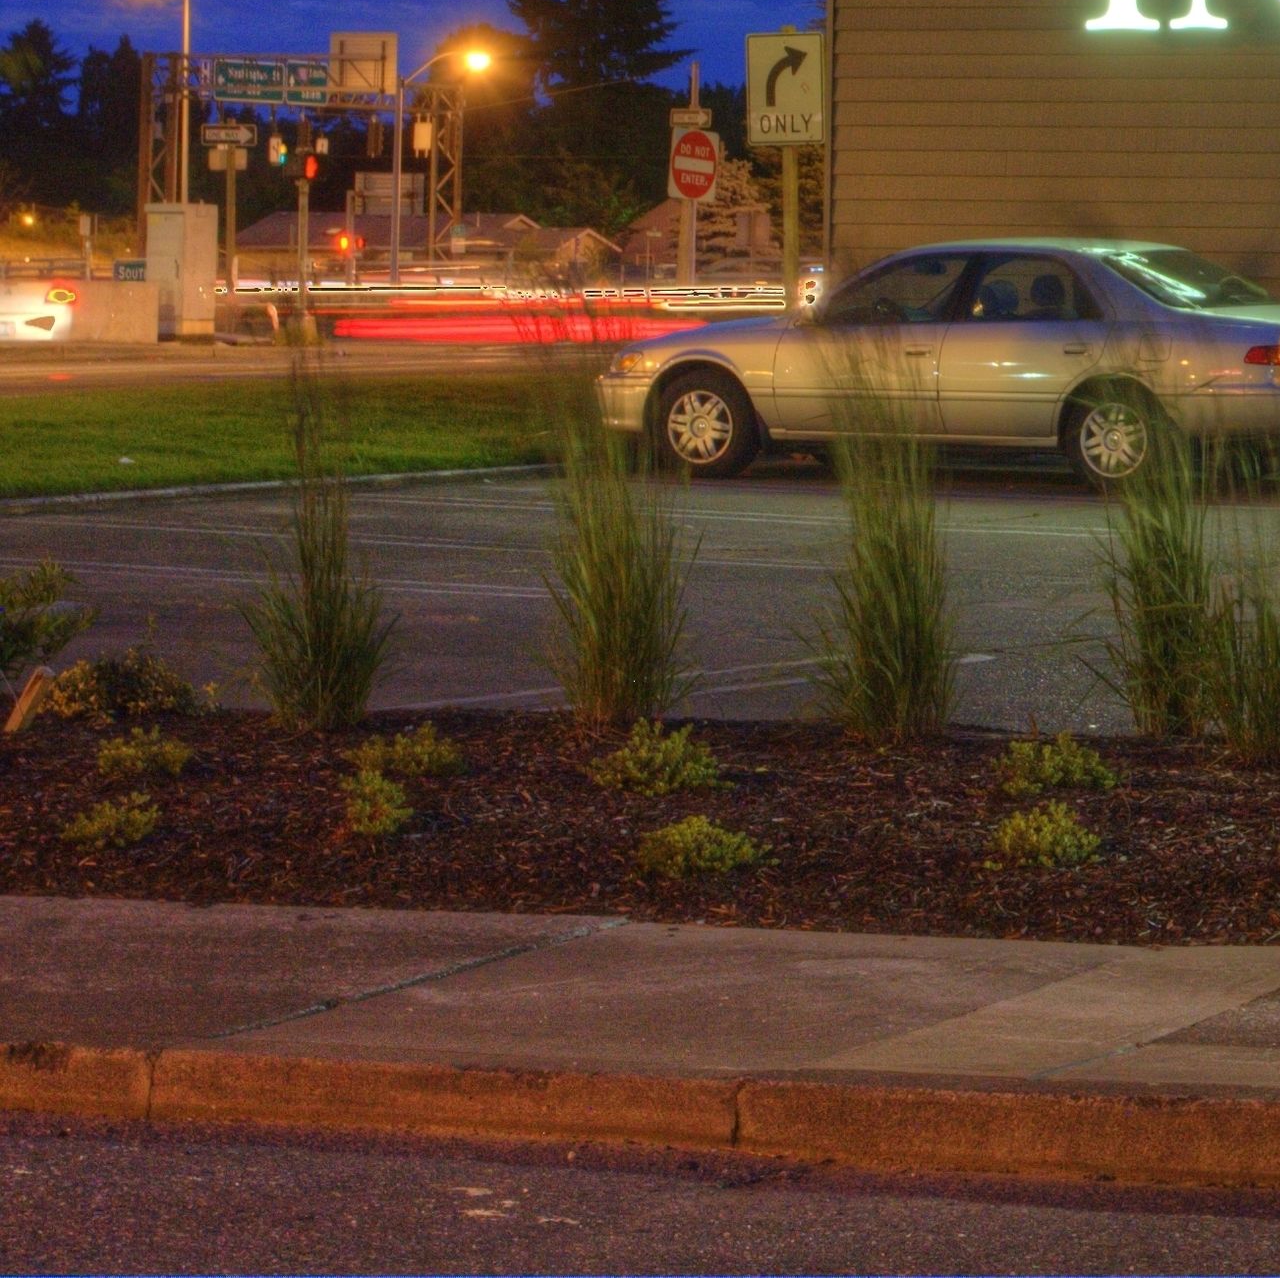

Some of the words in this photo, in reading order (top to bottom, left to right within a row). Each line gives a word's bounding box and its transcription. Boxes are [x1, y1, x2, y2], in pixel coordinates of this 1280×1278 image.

[760, 113, 813, 135] ONLY
[680, 143, 692, 156] DO
[694, 145, 711, 157] NOT
[680, 173, 706, 186] ENTER
